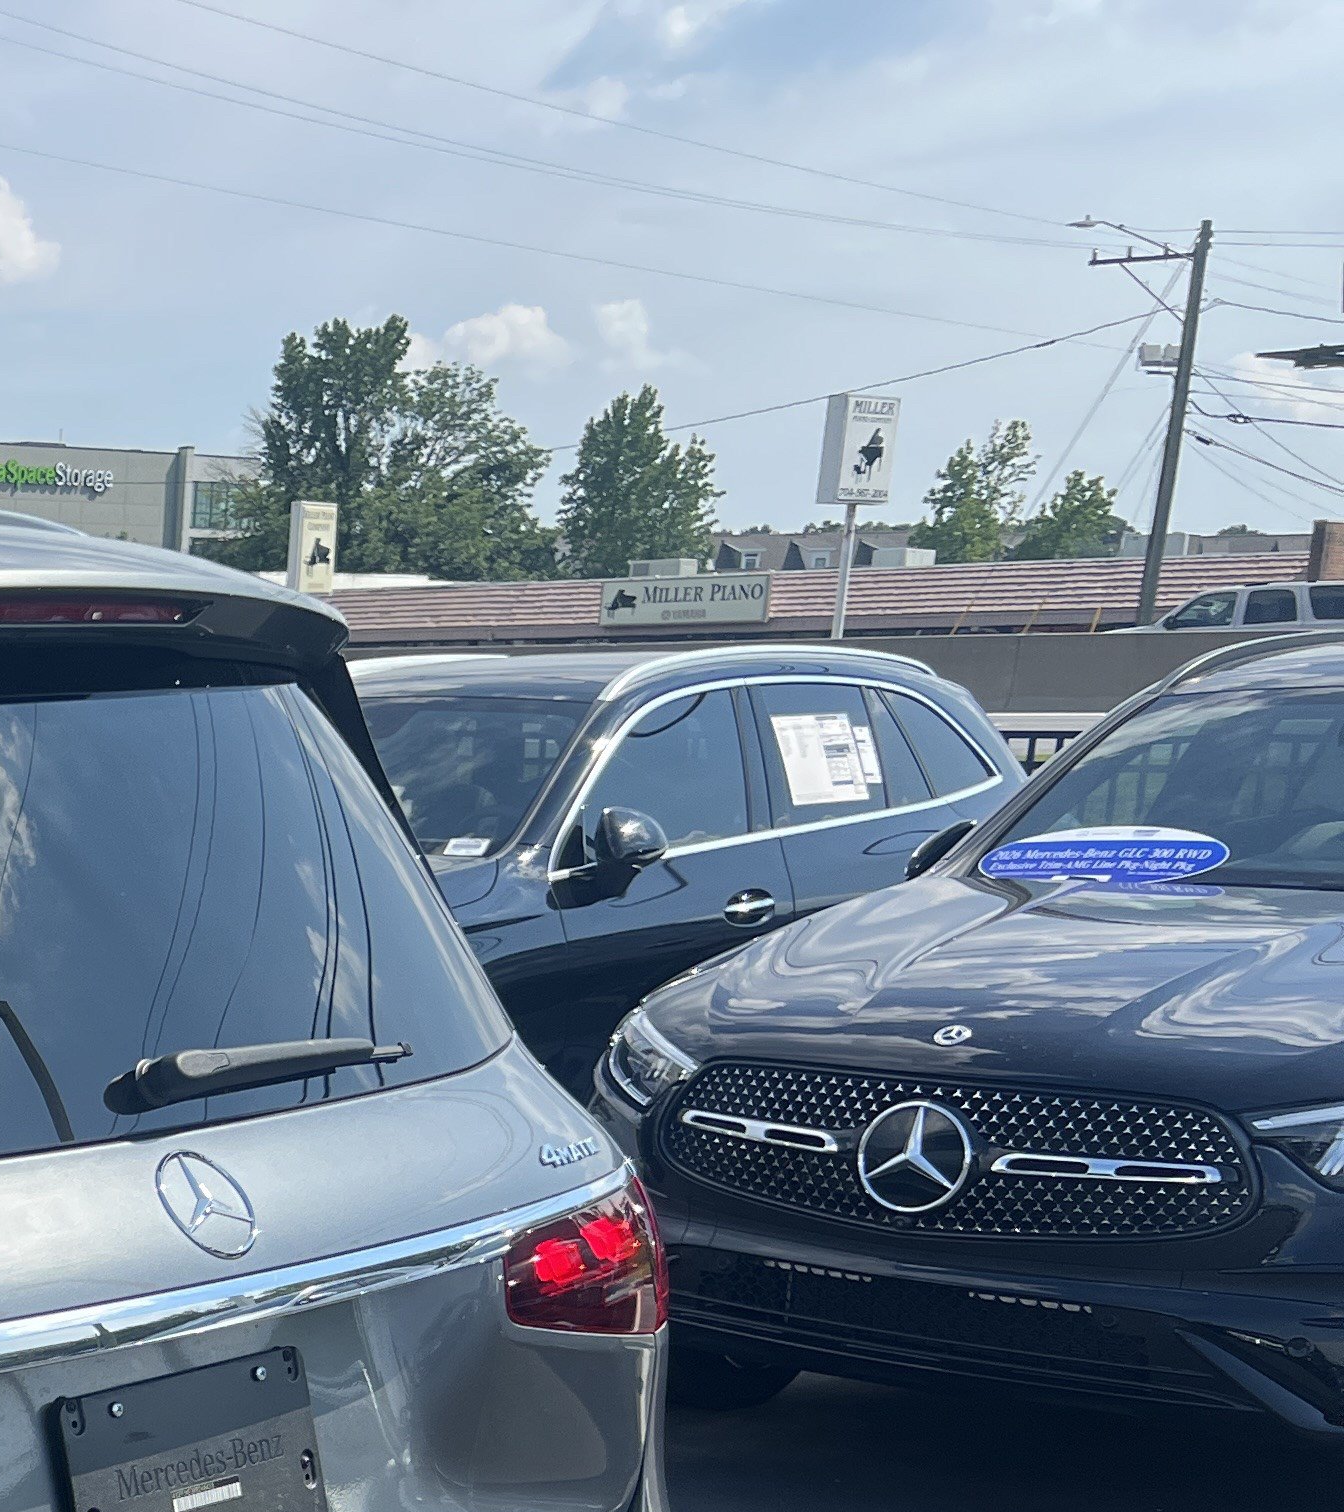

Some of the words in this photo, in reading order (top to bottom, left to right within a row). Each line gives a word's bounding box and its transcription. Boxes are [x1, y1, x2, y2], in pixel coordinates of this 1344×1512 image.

[852, 400, 896, 415] MILLER
[642, 585, 704, 604] MILLER
[710, 583, 764, 602] PIANO
[1023, 848, 1117, 859] Mercedes-Benz
[1118, 848, 1149, 858] GLC
[1148, 848, 1175, 858] 300
[1174, 849, 1212, 859] RWD
[115, 1434, 285, 1502] Mercedes-Benz
